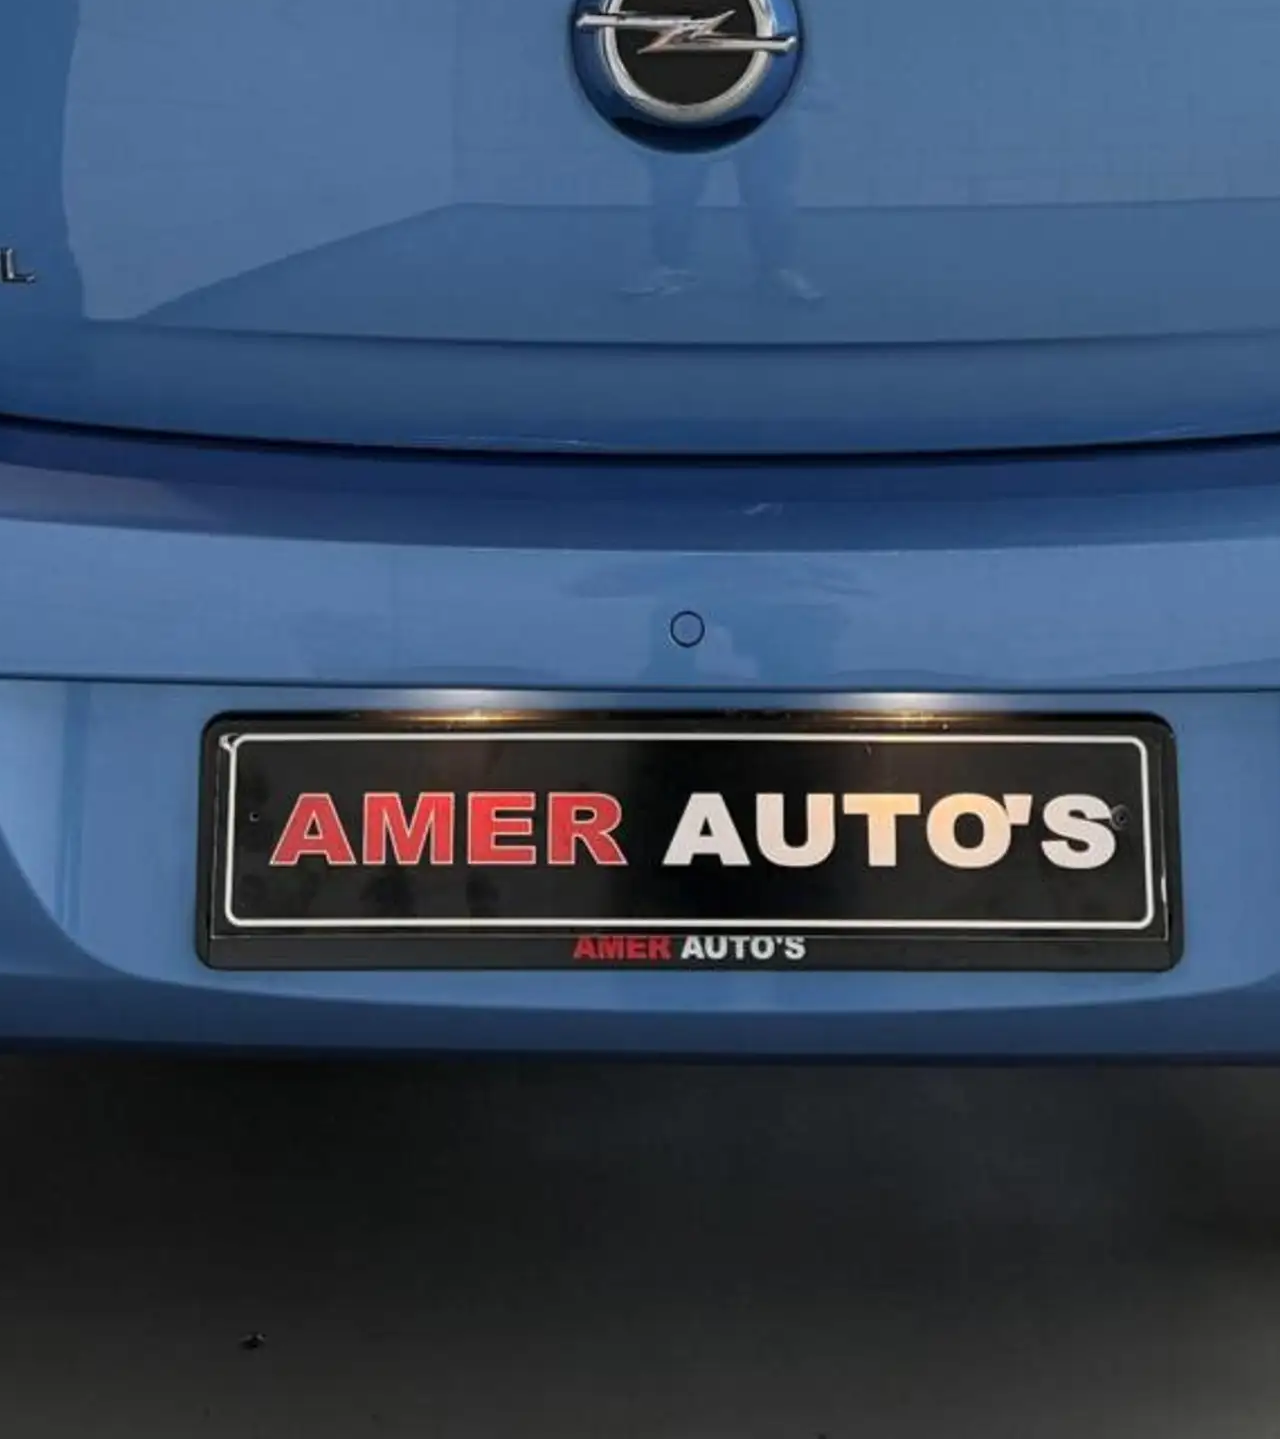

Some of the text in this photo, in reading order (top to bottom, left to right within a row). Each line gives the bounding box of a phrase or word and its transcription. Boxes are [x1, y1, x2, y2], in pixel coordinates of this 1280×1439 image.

[268, 791, 1118, 870] AMER AUTO'S
[573, 935, 807, 961] AMER AUTO'S
